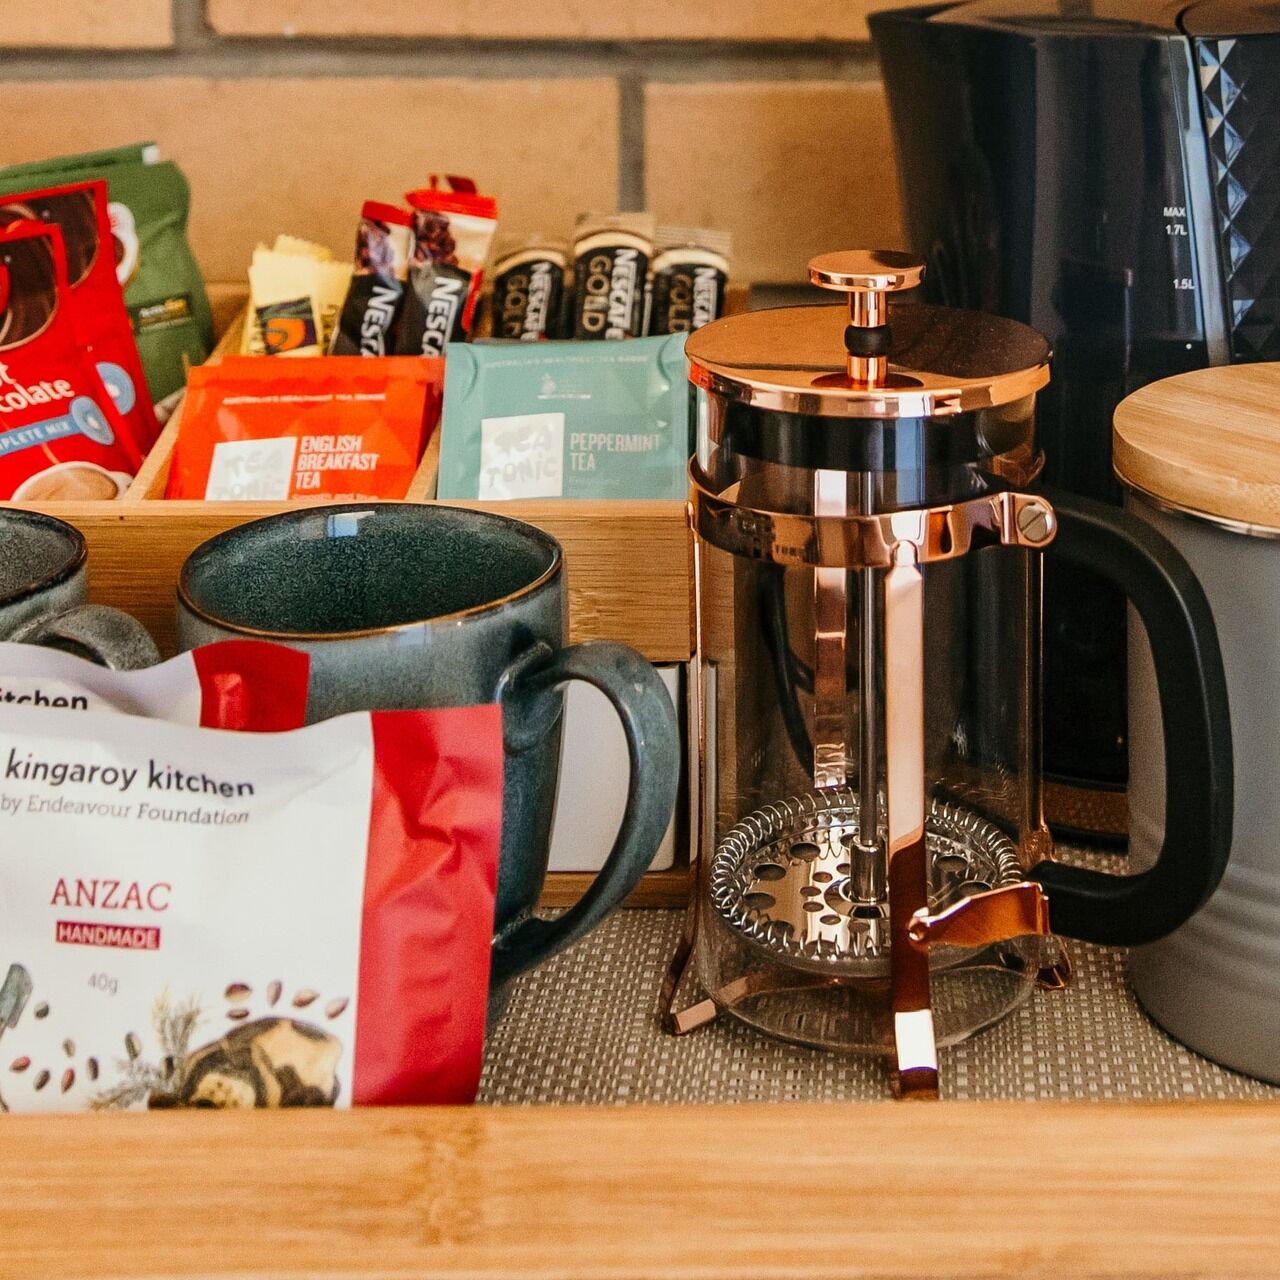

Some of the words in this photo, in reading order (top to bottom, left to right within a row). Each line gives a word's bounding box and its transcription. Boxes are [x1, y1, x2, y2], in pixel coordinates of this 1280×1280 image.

[1163, 207, 1186, 217] MAX
[1165, 225, 1187, 236] 1.7L
[582, 255, 612, 332] GOLD
[1173, 279, 1195, 290] 1.5L
[668, 274, 693, 333] GOLD
[45, 421, 70, 436] MIX
[300, 435, 363, 452] ENGLISH
[571, 432, 661, 452] PEPPERMINT
[297, 453, 380, 471] BREAKFAST
[571, 452, 596, 470] TEA
[295, 471, 321, 489] TEA
[5, 748, 137, 792] kingaroy
[147, 759, 255, 798] kitchen
[1, 793, 22, 813] by
[26, 795, 131, 819] Endeavour
[137, 803, 249, 825] Foundation
[50, 878, 172, 911] ANZAC
[58, 923, 157, 949] HANDMADE
[88, 972, 118, 997] 40g
